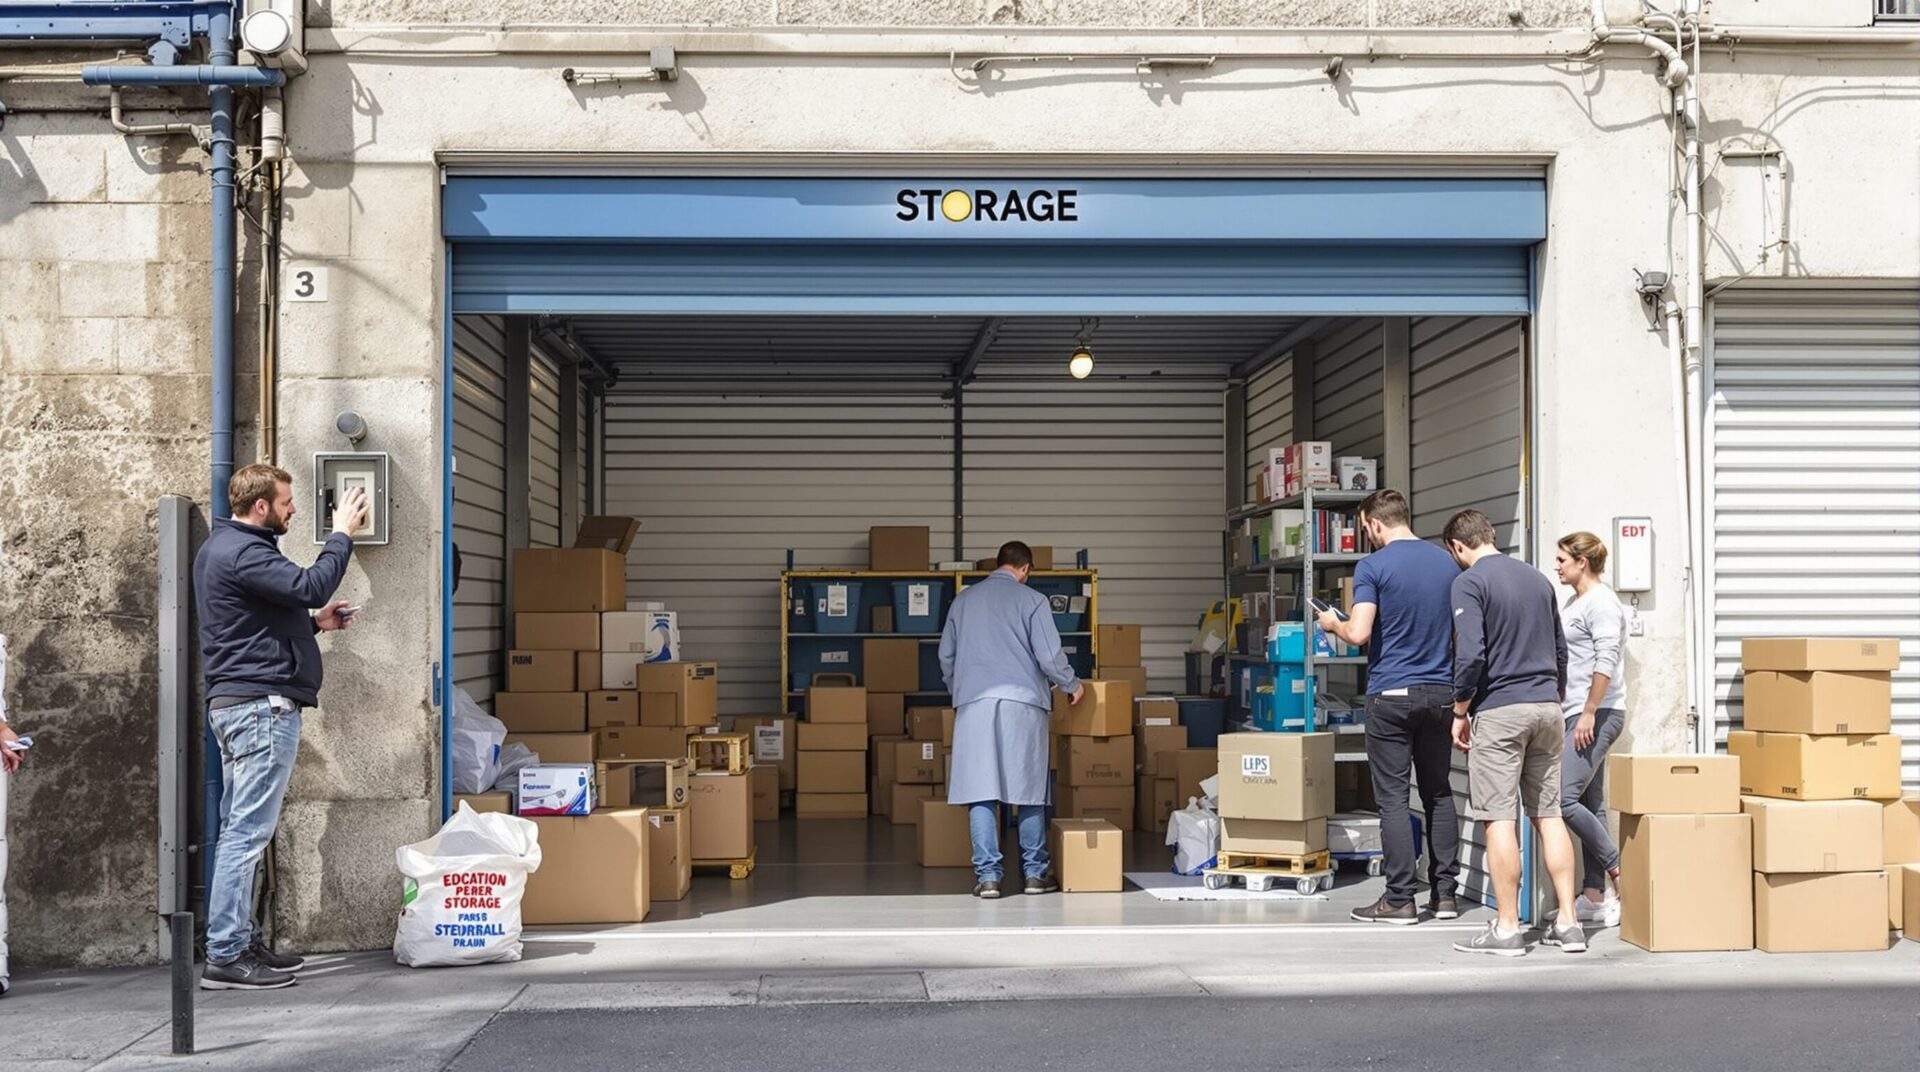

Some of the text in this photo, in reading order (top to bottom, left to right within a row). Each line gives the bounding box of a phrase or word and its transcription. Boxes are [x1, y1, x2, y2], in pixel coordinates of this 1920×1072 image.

[896, 189, 1078, 222] STORAGE
[295, 271, 314, 297] 3
[1622, 526, 1646, 537] EDT
[443, 873, 507, 887] EDCATION
[444, 897, 502, 909] STORAGE
